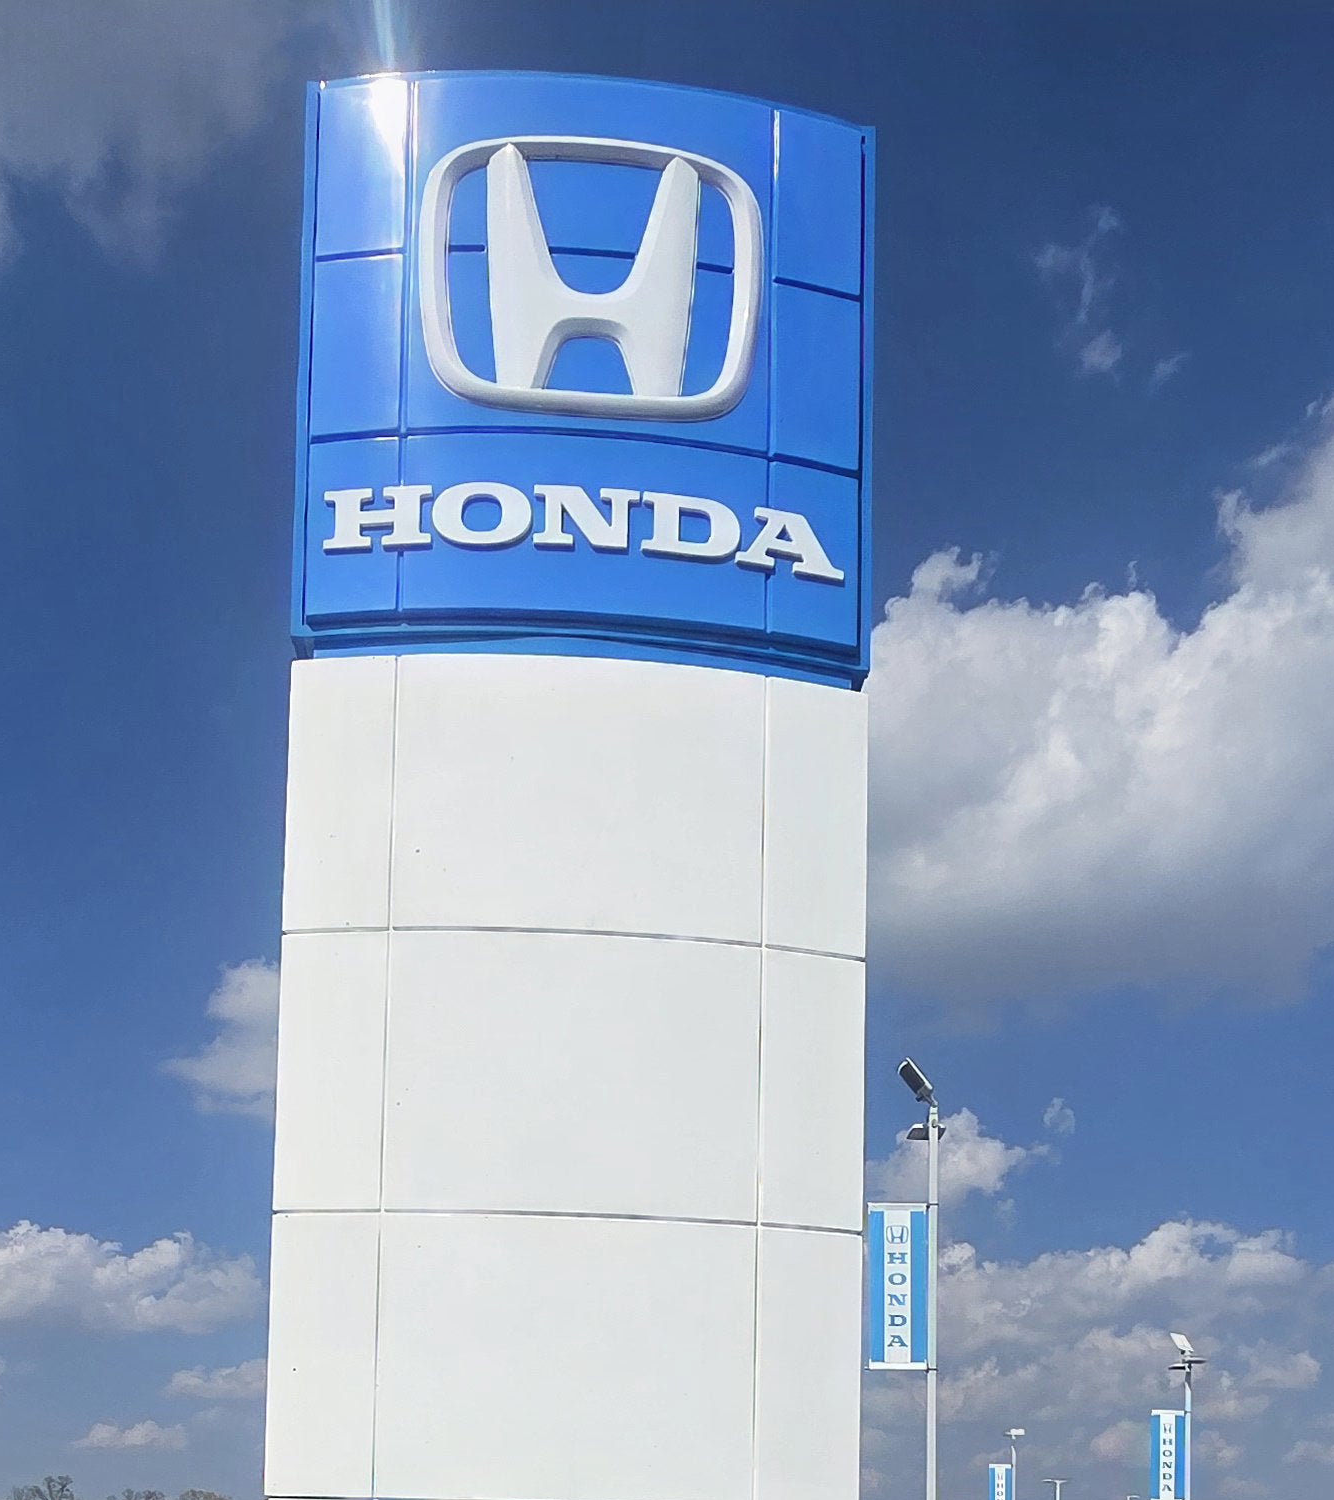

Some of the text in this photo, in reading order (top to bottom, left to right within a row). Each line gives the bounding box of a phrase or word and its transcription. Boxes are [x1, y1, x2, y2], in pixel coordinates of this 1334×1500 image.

[323, 480, 845, 581] HONDA
[886, 1252, 909, 1348] HONDA
[1161, 1438, 1173, 1492] HONDA
